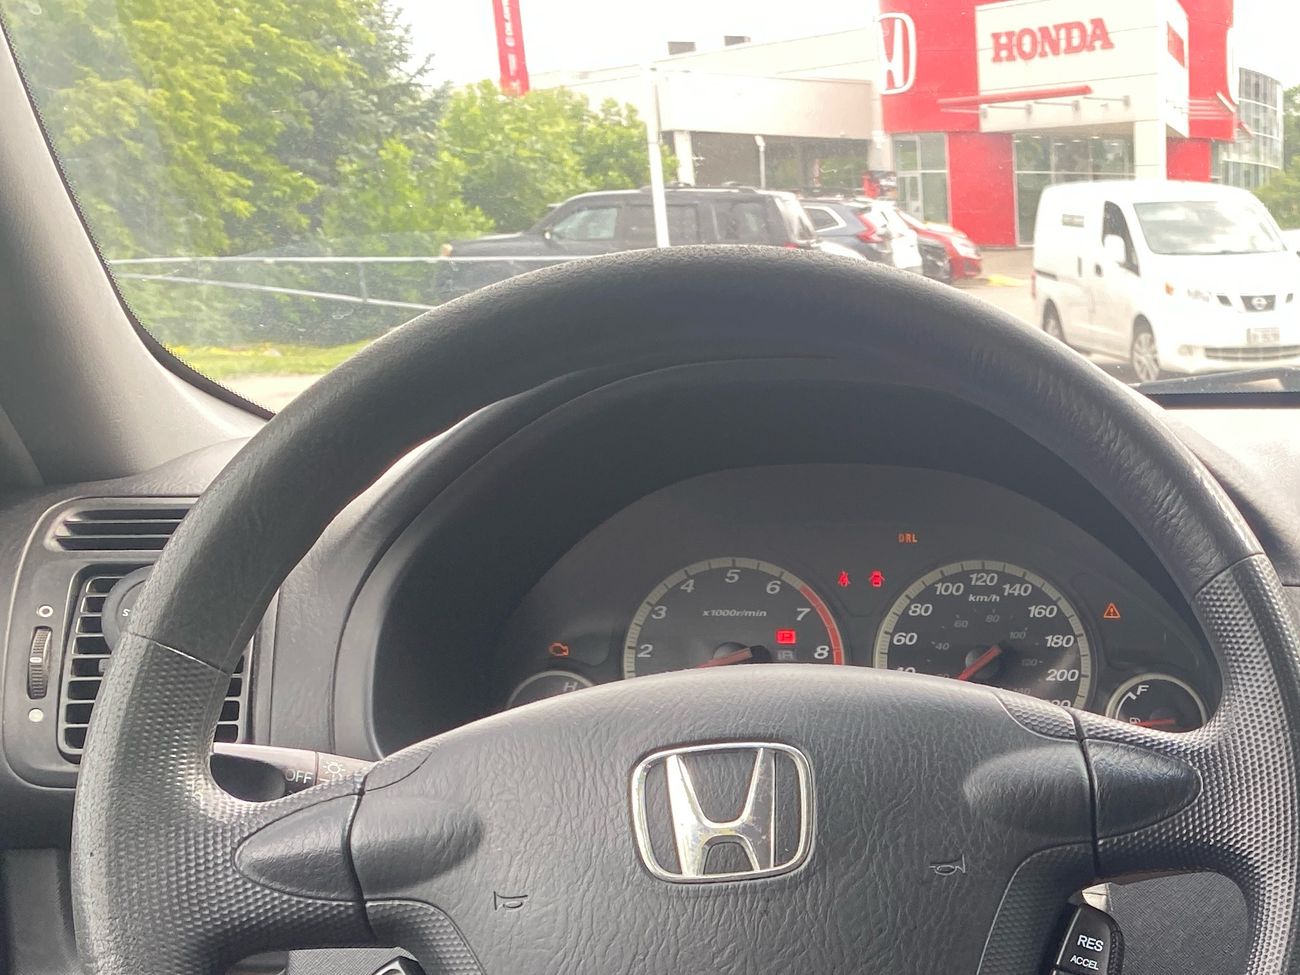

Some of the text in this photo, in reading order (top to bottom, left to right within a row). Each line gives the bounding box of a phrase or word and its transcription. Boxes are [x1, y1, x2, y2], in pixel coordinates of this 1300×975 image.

[990, 17, 1115, 63] HONDA
[724, 569, 741, 583] 5
[969, 572, 999, 586] 120
[680, 579, 696, 593] 4
[766, 580, 781, 594] 6
[934, 582, 964, 596] 100
[1002, 583, 1033, 597] 140
[968, 594, 1000, 603] km/h
[651, 605, 668, 619] 3
[796, 607, 811, 621] 7
[908, 603, 933, 617] 80
[1027, 604, 1058, 618] 160
[892, 632, 918, 645] 60
[1045, 634, 1075, 648] 180
[637, 644, 653, 658] 2
[814, 645, 830, 659] 8
[1045, 668, 1079, 682] 200
[1137, 684, 1150, 695] F
[285, 768, 313, 784] OFF
[1077, 934, 1104, 952] RES
[1070, 954, 1099, 971] ACCEL
